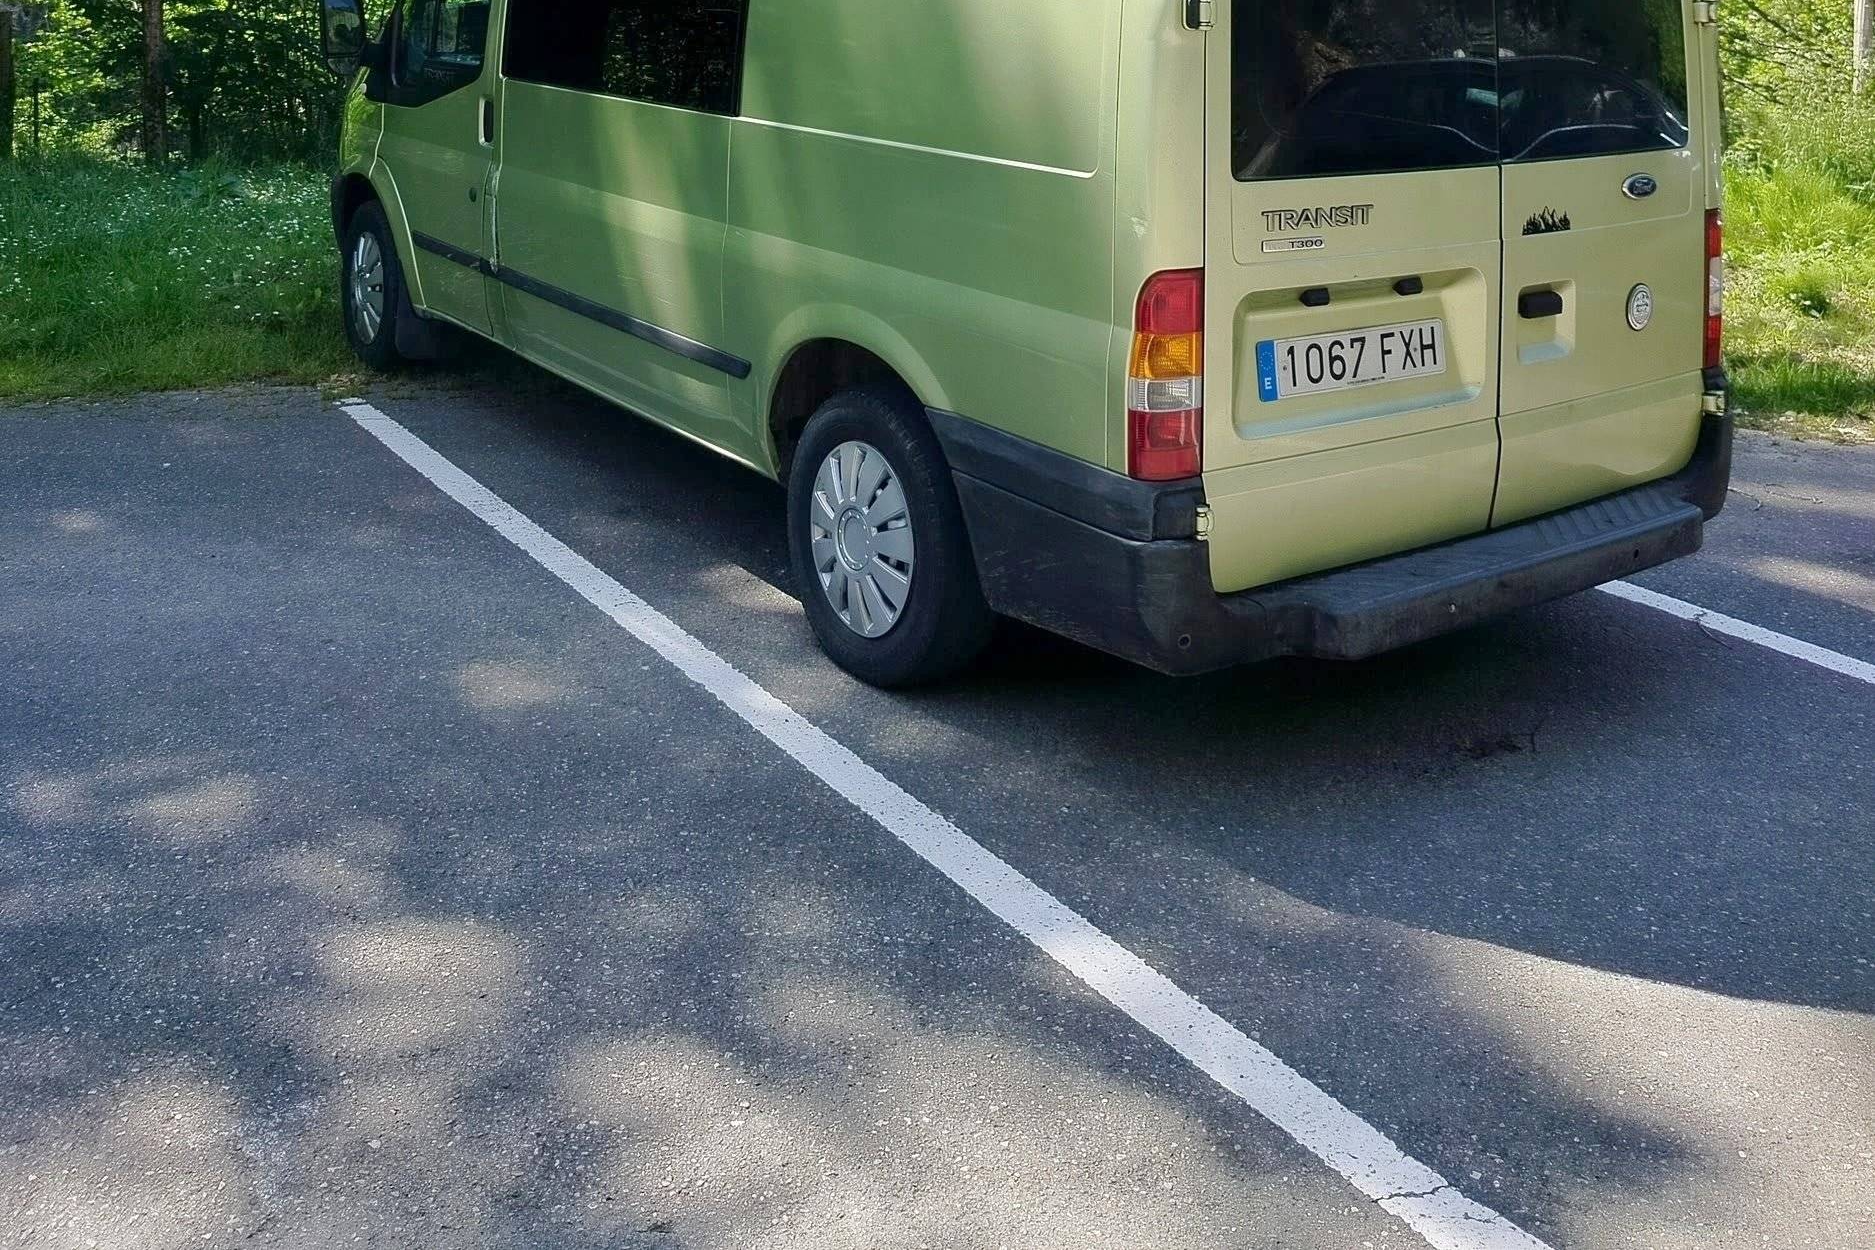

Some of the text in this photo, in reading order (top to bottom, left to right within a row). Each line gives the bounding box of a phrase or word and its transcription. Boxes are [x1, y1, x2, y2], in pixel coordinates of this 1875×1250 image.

[1261, 204, 1374, 232] TRANSIT
[1289, 238, 1323, 249] T300
[1286, 326, 1438, 387] 1067 FXH
[1264, 377, 1273, 390] E
